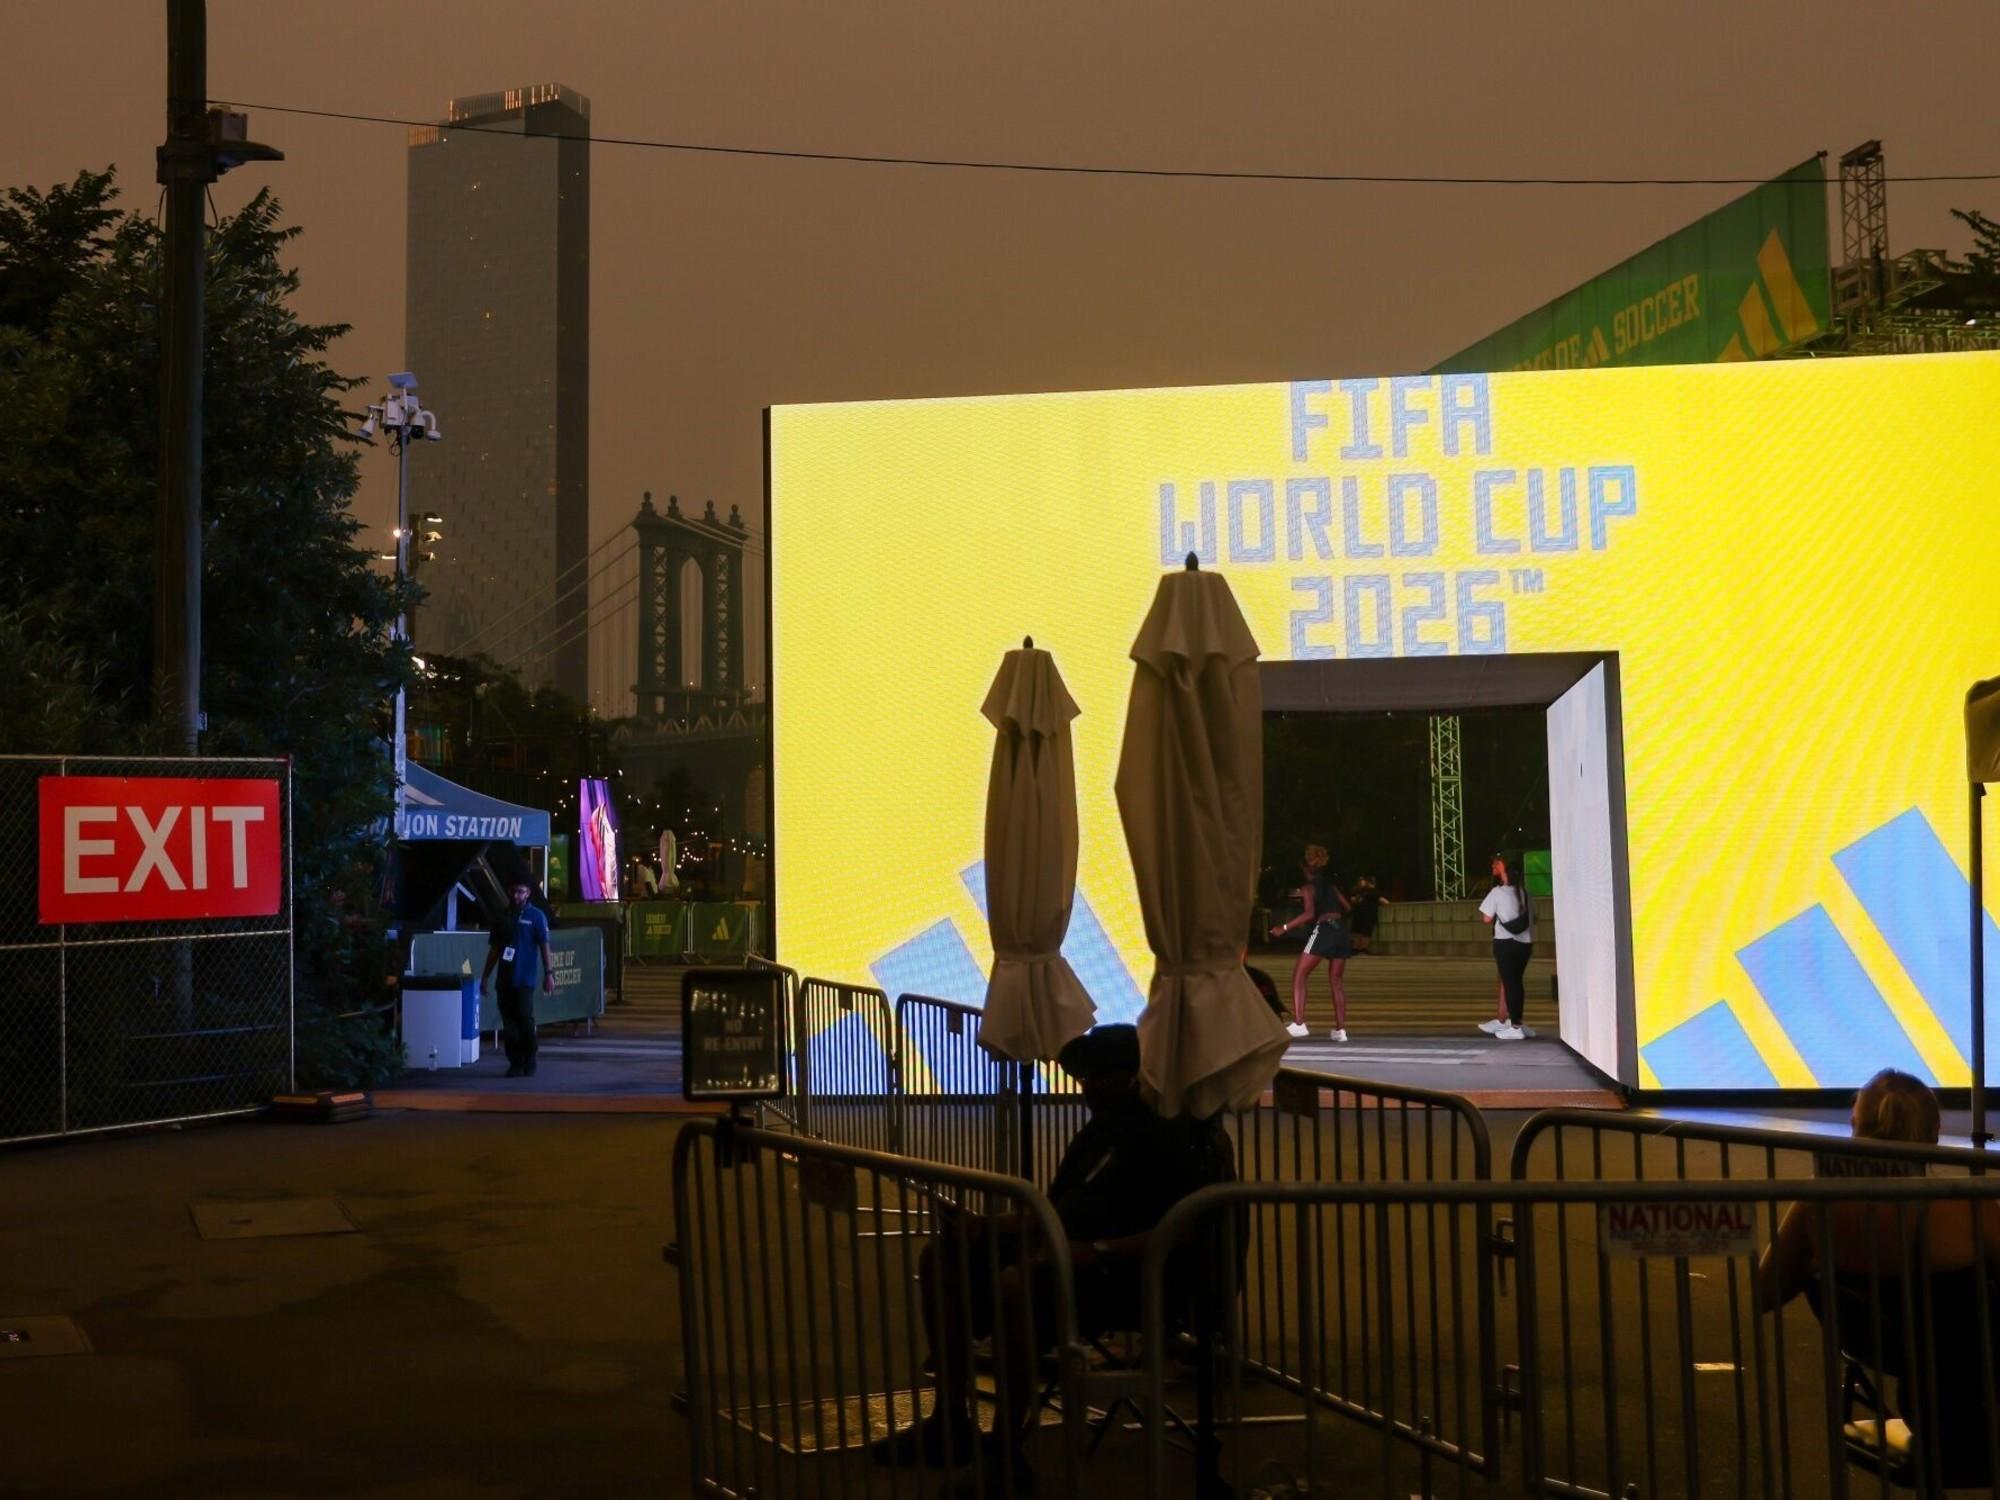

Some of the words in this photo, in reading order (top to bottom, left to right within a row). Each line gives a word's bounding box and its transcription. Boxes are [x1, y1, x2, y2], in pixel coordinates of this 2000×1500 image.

[1612, 272, 1700, 355] SOCCER
[1289, 372, 1491, 462] FIFA
[1159, 473, 1438, 566] WORLD
[1473, 465, 1638, 555] CUP
[63, 806, 265, 894] EXIT
[444, 816, 523, 838] STATION
[725, 1019, 742, 1033] NO
[1608, 1204, 1752, 1232] NATIONAL
